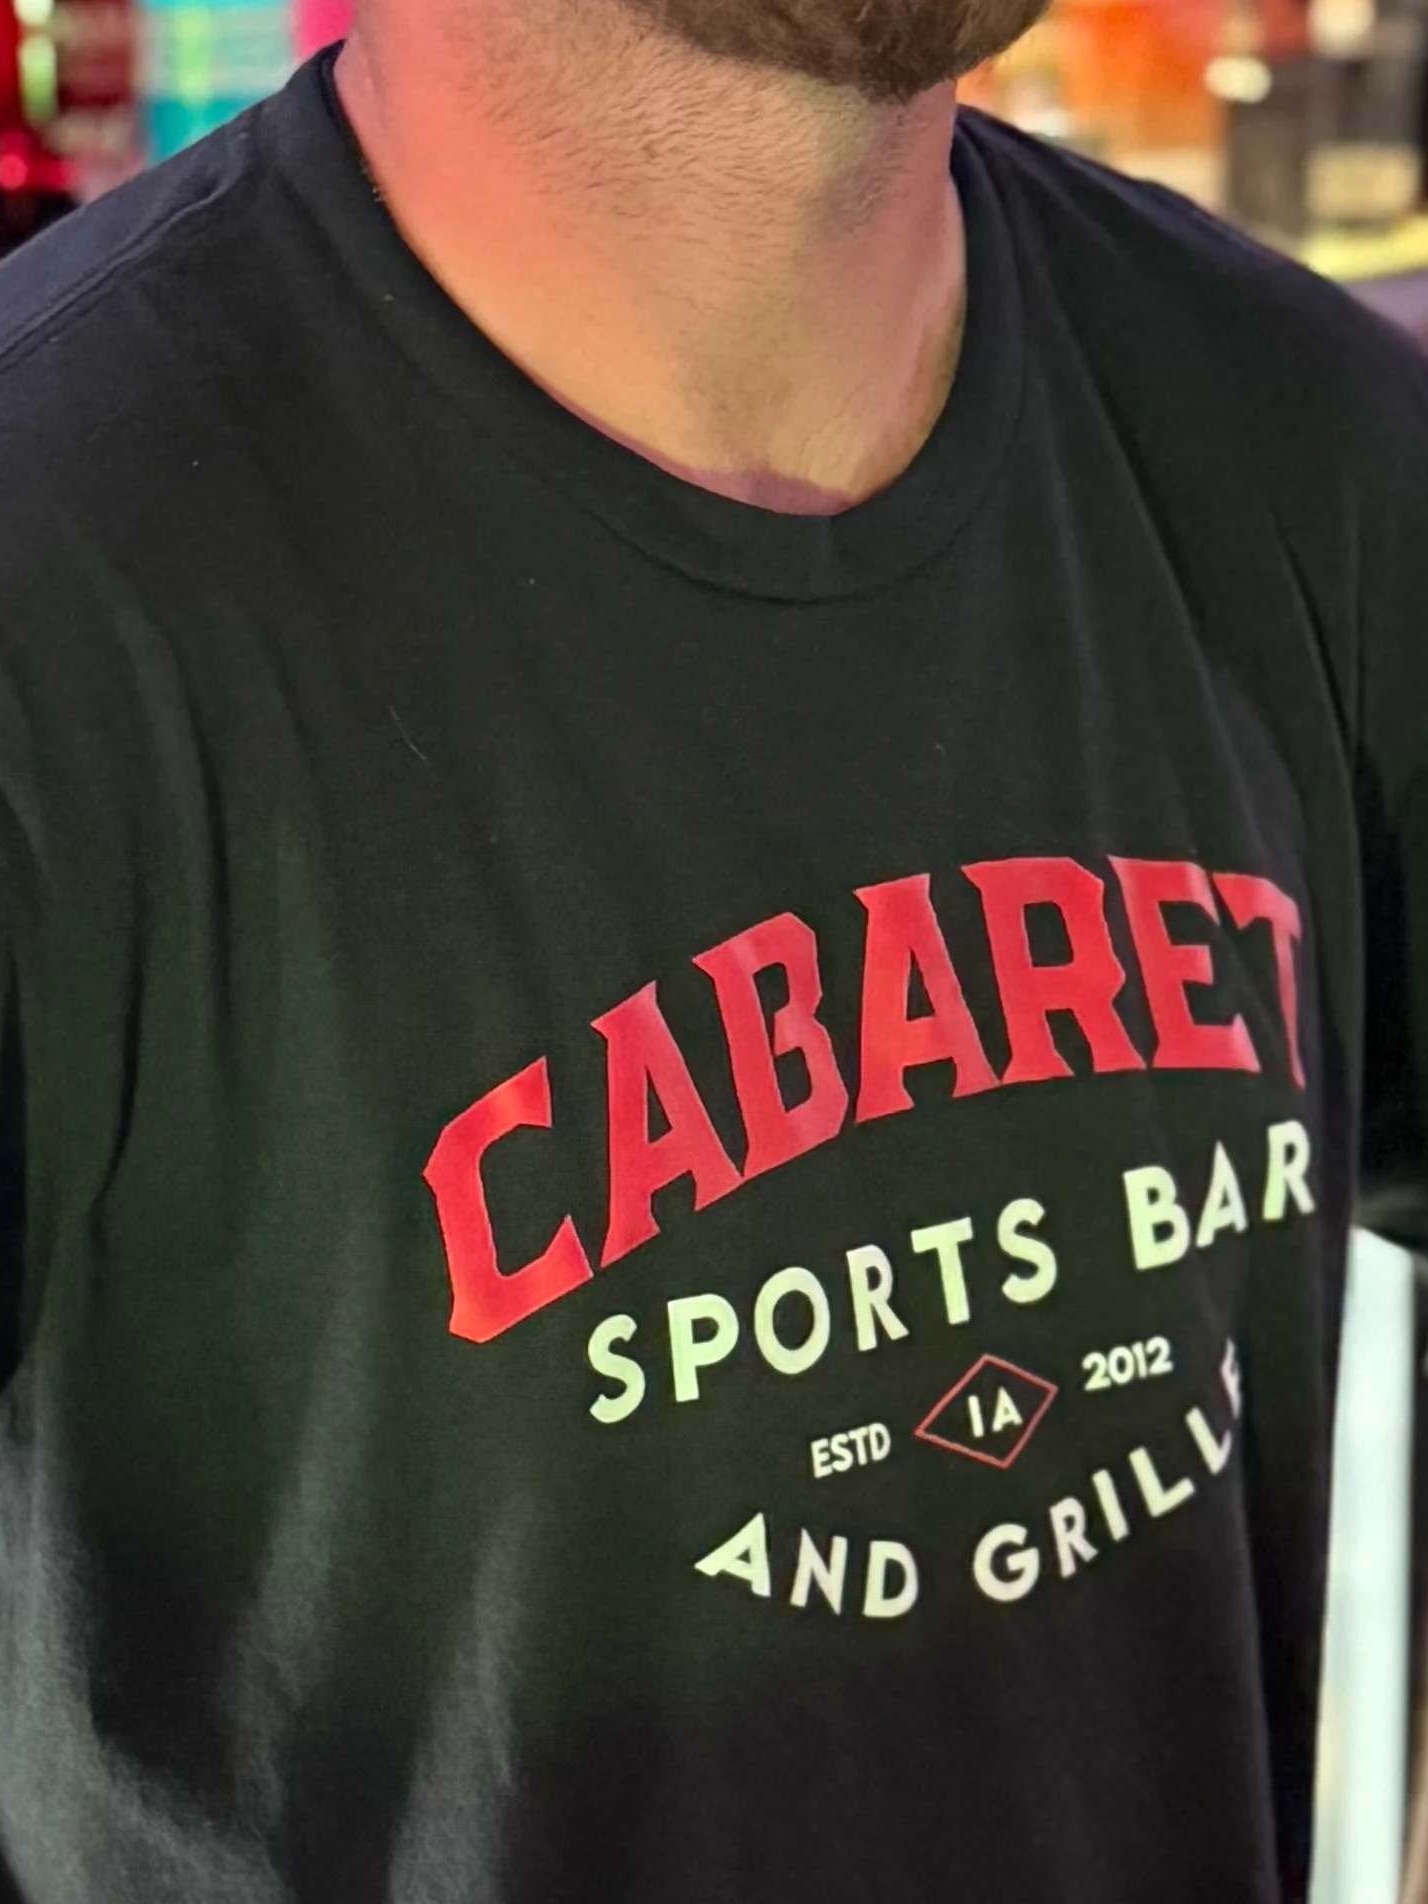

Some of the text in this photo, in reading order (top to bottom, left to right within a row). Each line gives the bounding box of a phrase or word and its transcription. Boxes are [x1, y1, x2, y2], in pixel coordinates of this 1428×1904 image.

[423, 854, 1306, 1344] CABARET
[587, 1120, 1317, 1424] SPORTS BAR
[810, 1421, 893, 1479] ESTD
[1082, 1335, 1174, 1392] 2012
[694, 1511, 919, 1619] AND
